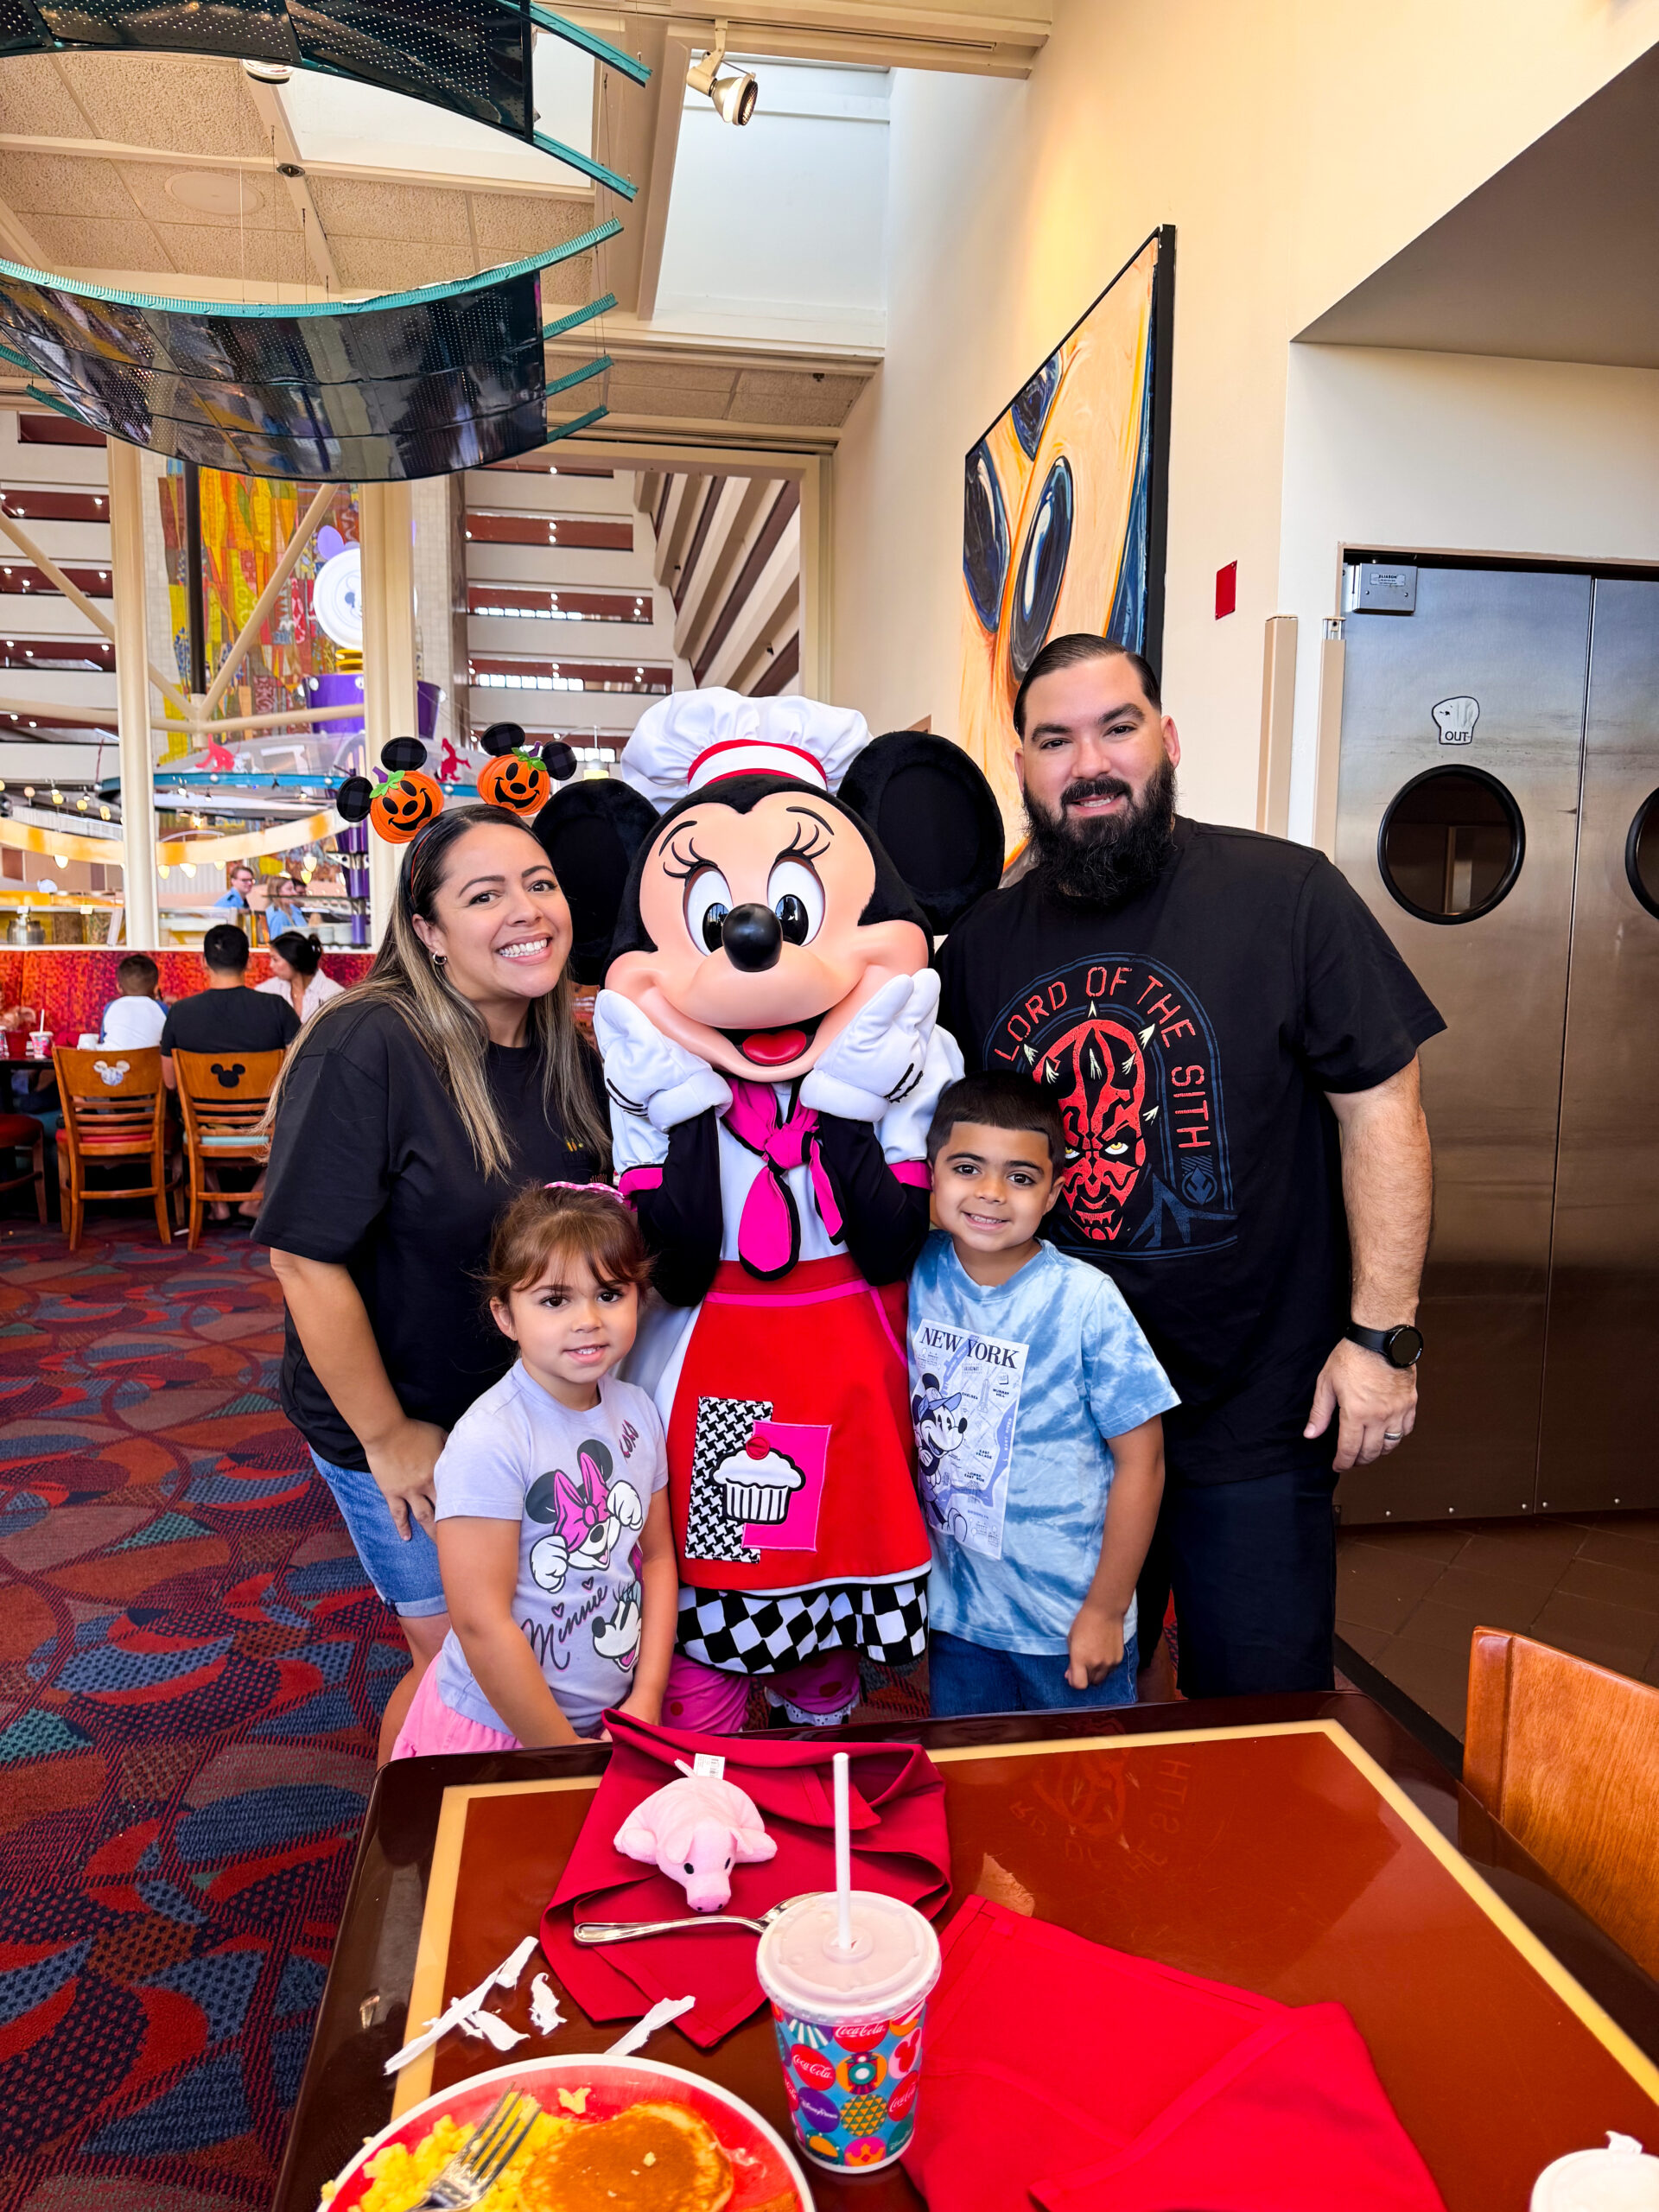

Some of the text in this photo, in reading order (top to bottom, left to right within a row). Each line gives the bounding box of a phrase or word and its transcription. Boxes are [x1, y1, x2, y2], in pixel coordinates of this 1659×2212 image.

[1445, 730, 1469, 741] OUT
[995, 966, 1211, 1149] LORD OF THE SITH
[919, 1327, 963, 1352] NEW
[967, 1338, 1020, 1369] YORK
[520, 1586, 607, 1670] Minnie
